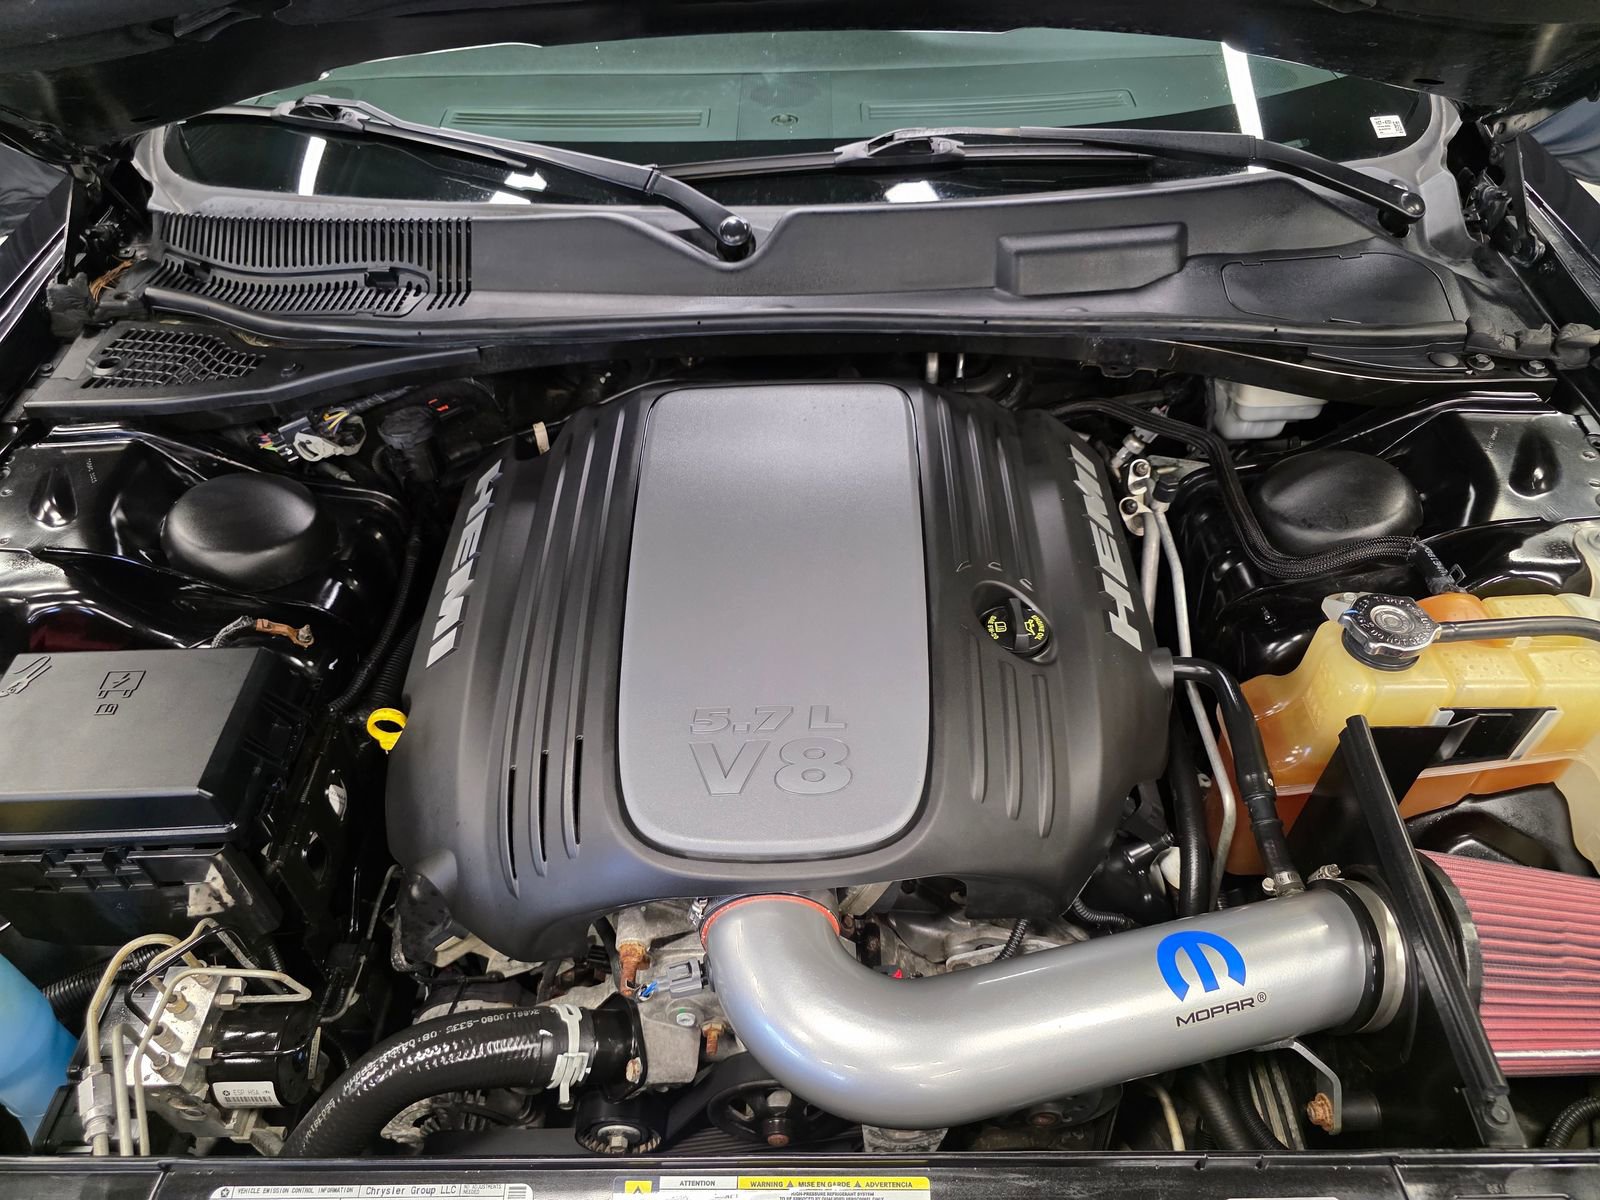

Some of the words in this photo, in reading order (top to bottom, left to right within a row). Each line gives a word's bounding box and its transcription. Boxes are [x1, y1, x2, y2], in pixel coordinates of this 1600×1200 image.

[433, 458, 502, 669] HEMI
[1070, 443, 1143, 652] HEMI
[689, 706, 795, 734] 5.7
[808, 704, 848, 731] L
[688, 737, 853, 796] V8
[365, 1186, 405, 1197] Chrysler
[410, 1186, 436, 1196] Group
[440, 1185, 457, 1194] LLC
